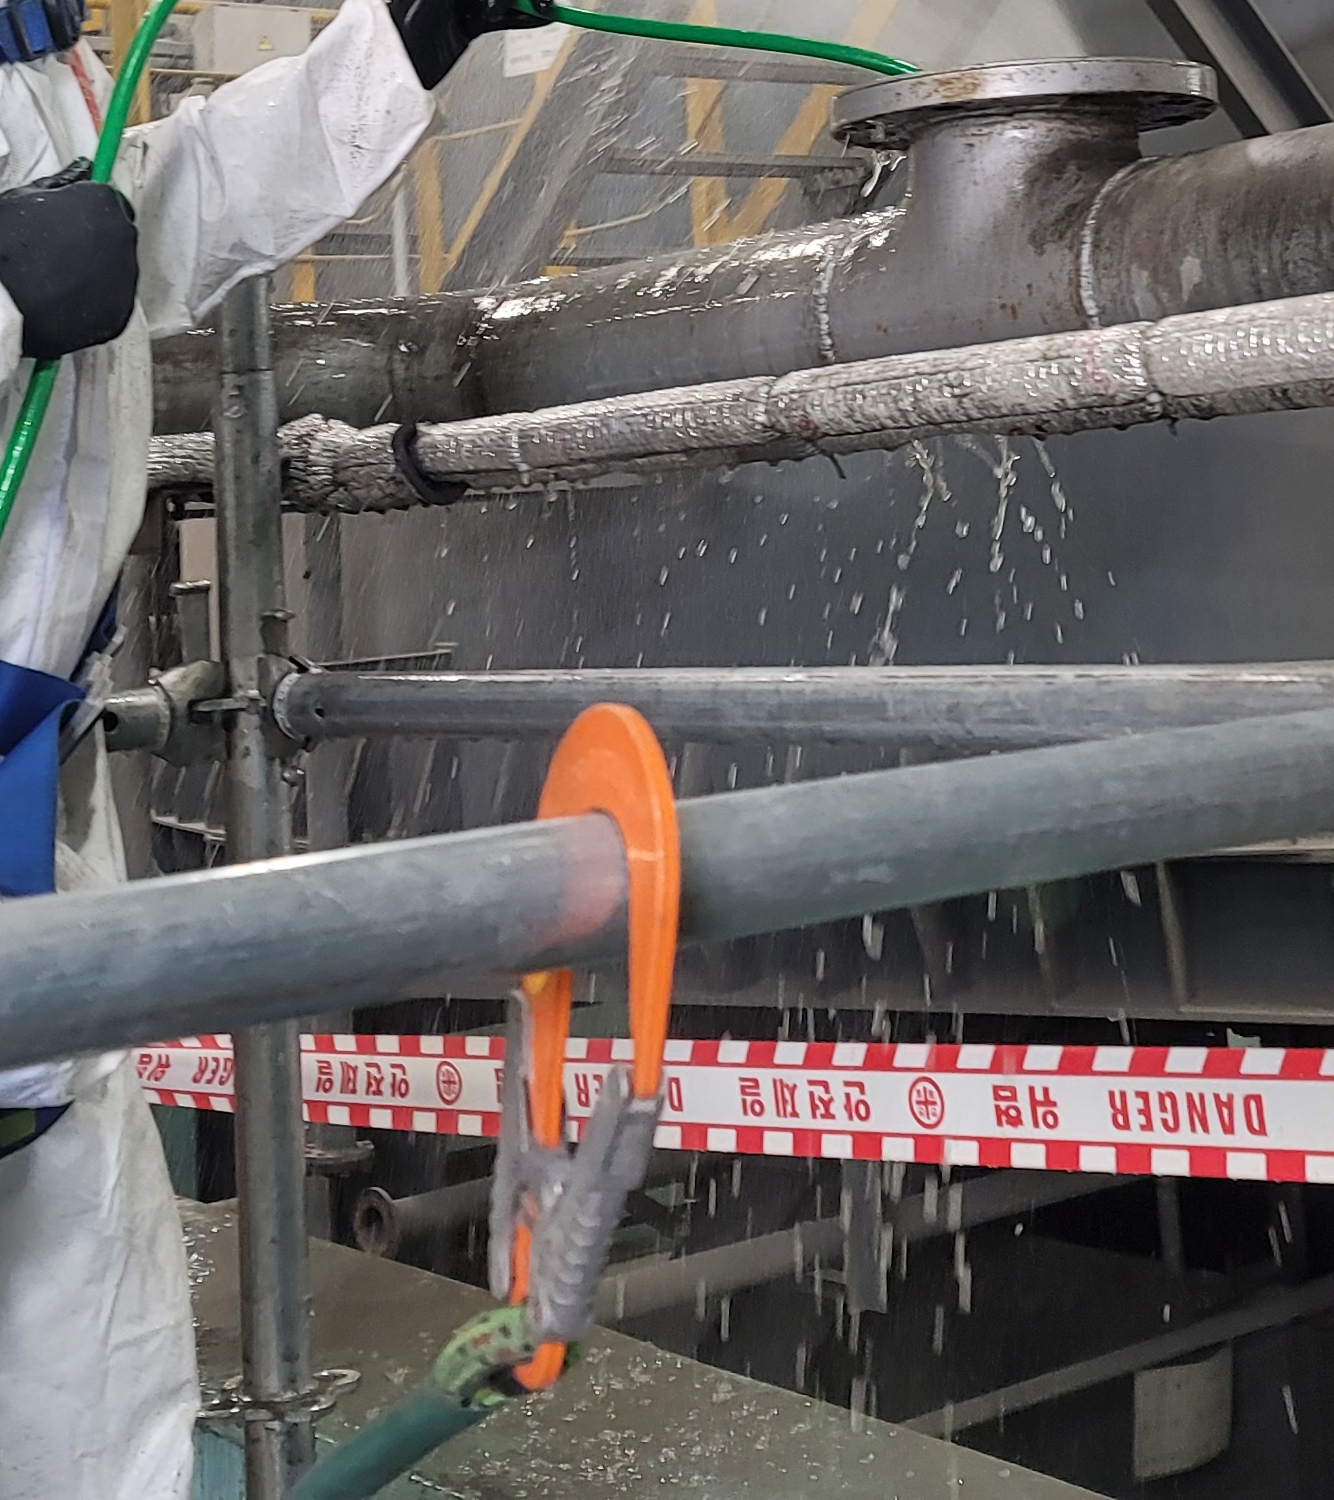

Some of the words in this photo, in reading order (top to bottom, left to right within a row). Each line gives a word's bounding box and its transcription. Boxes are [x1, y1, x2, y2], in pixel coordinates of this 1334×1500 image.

[315, 1059, 410, 1099] 안전제일
[738, 1076, 872, 1122] 안전제일
[992, 1084, 1060, 1131] 위험
[1107, 1089, 1268, 1137] DANGER
